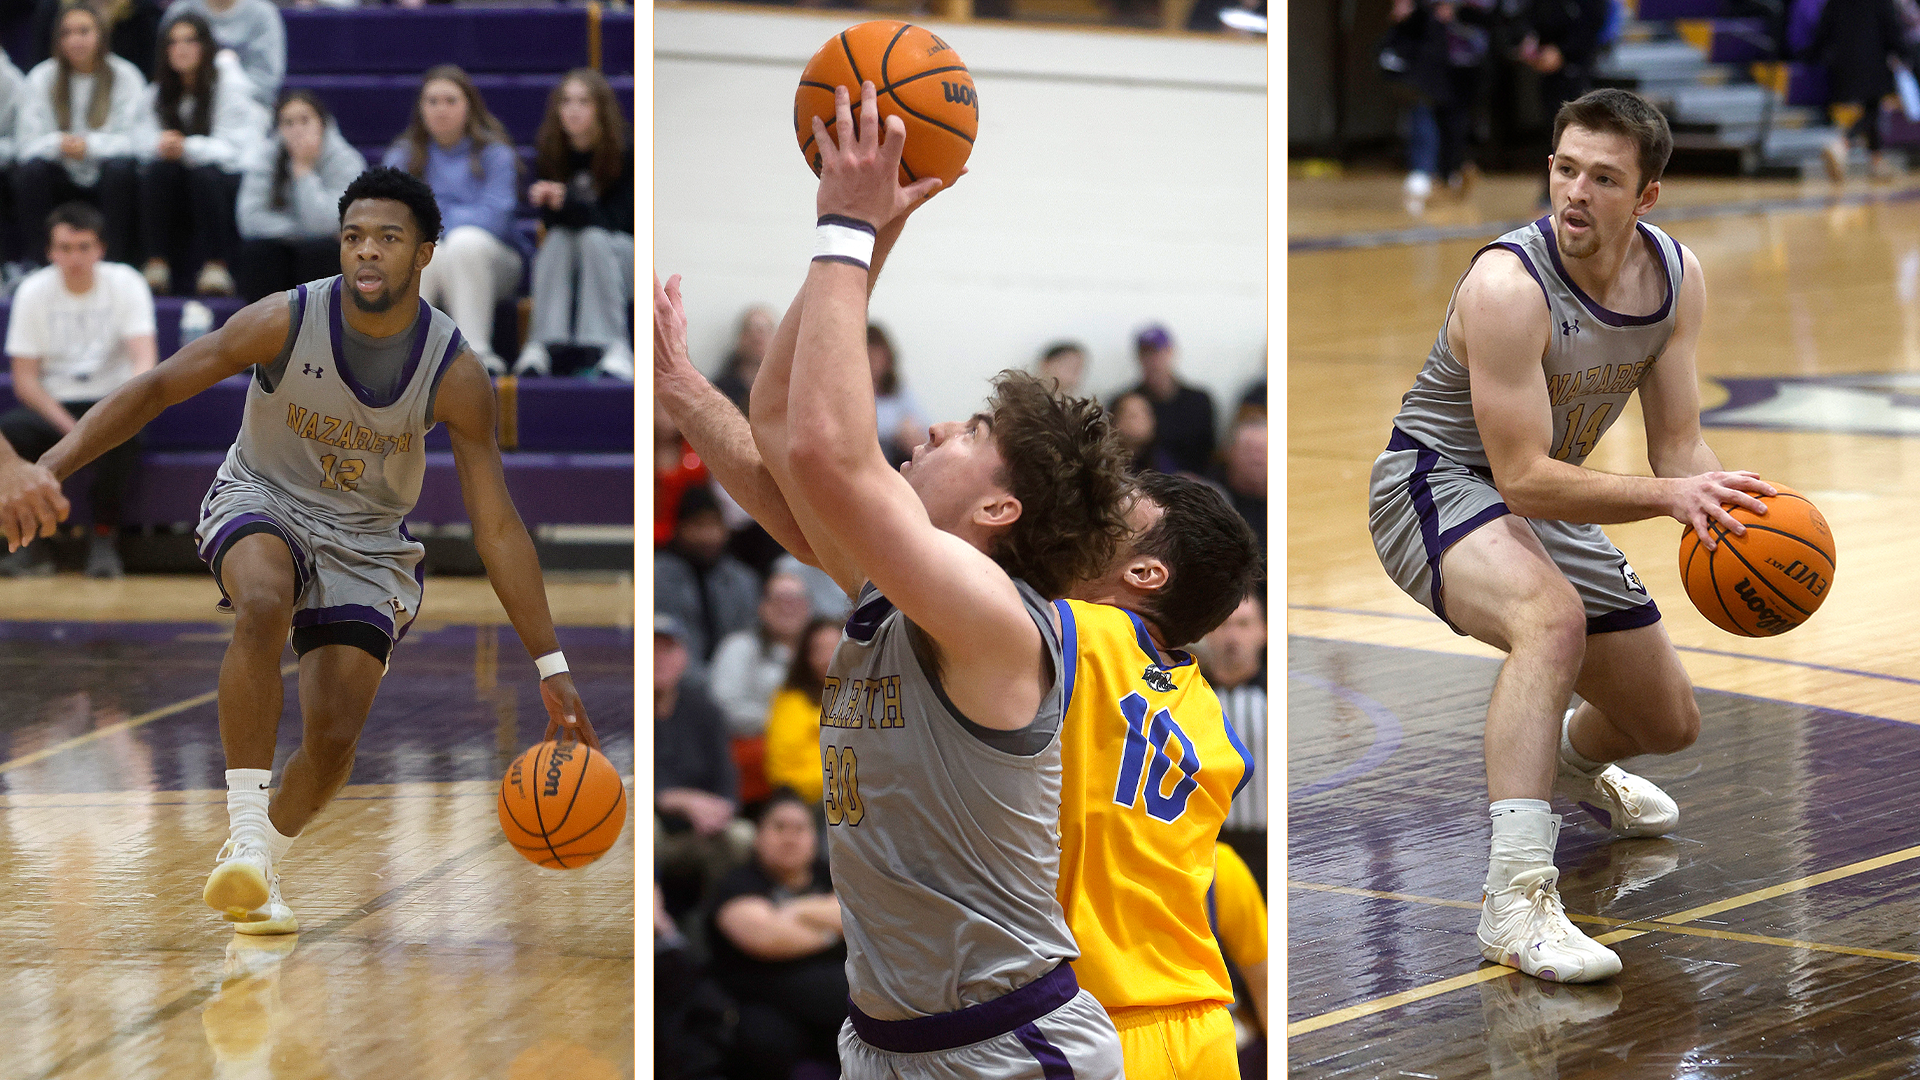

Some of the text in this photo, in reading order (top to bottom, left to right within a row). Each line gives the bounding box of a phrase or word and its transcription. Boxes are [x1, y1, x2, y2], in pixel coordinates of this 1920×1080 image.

[1548, 355, 1656, 407] NAZARE
[286, 402, 412, 459] NAZARETH
[1553, 403, 1613, 460] 14
[320, 453, 366, 492] 12
[1764, 557, 1828, 597] EVO NXT
[825, 745, 864, 827] 30
[1112, 690, 1202, 825] 10
